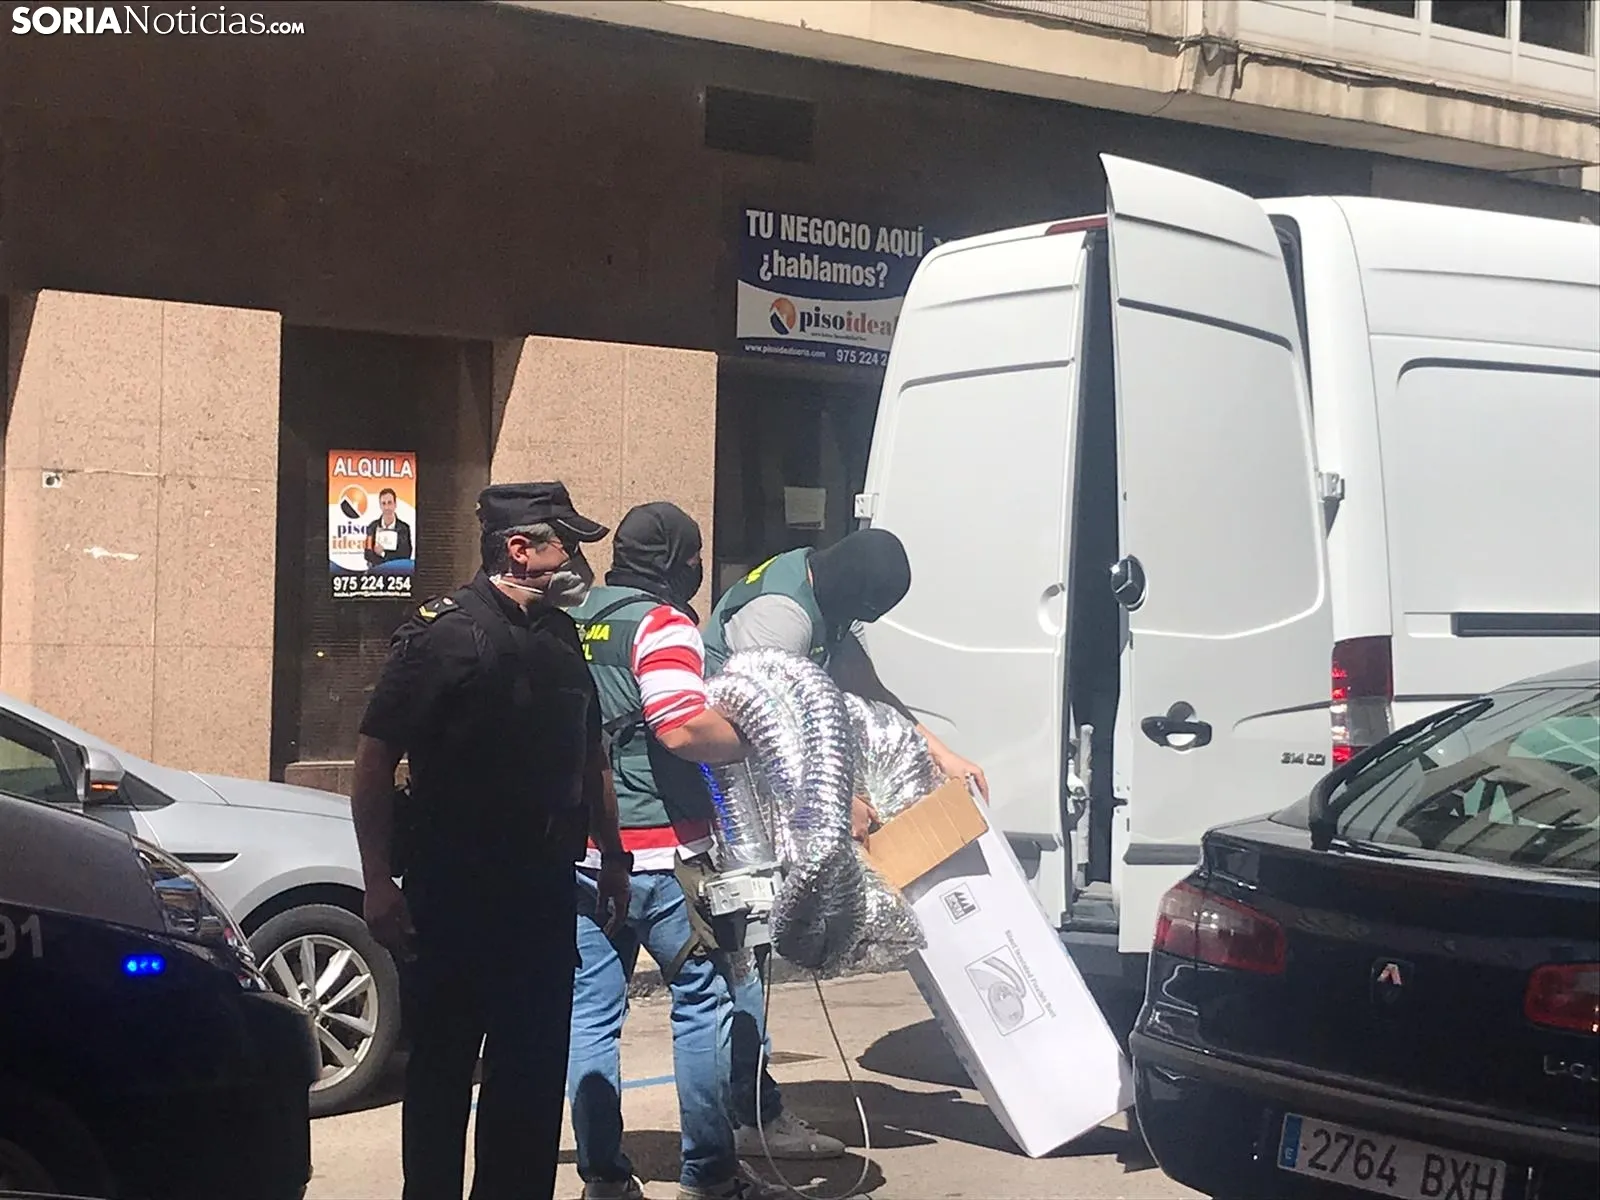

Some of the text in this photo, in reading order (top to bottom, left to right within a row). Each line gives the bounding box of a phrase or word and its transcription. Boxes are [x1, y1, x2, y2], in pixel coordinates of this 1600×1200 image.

[746, 209, 924, 258] TU NEGOCIO AQUÍ
[759, 249, 889, 288] ¿hablamos?
[836, 348, 857, 363] 975
[858, 351, 879, 366] 224
[333, 457, 414, 478] ALQUILA
[333, 576, 411, 591] 975 224 254
[1285, 1147, 1294, 1160] E
[1308, 1128, 1497, 1200] 2764 BXH
